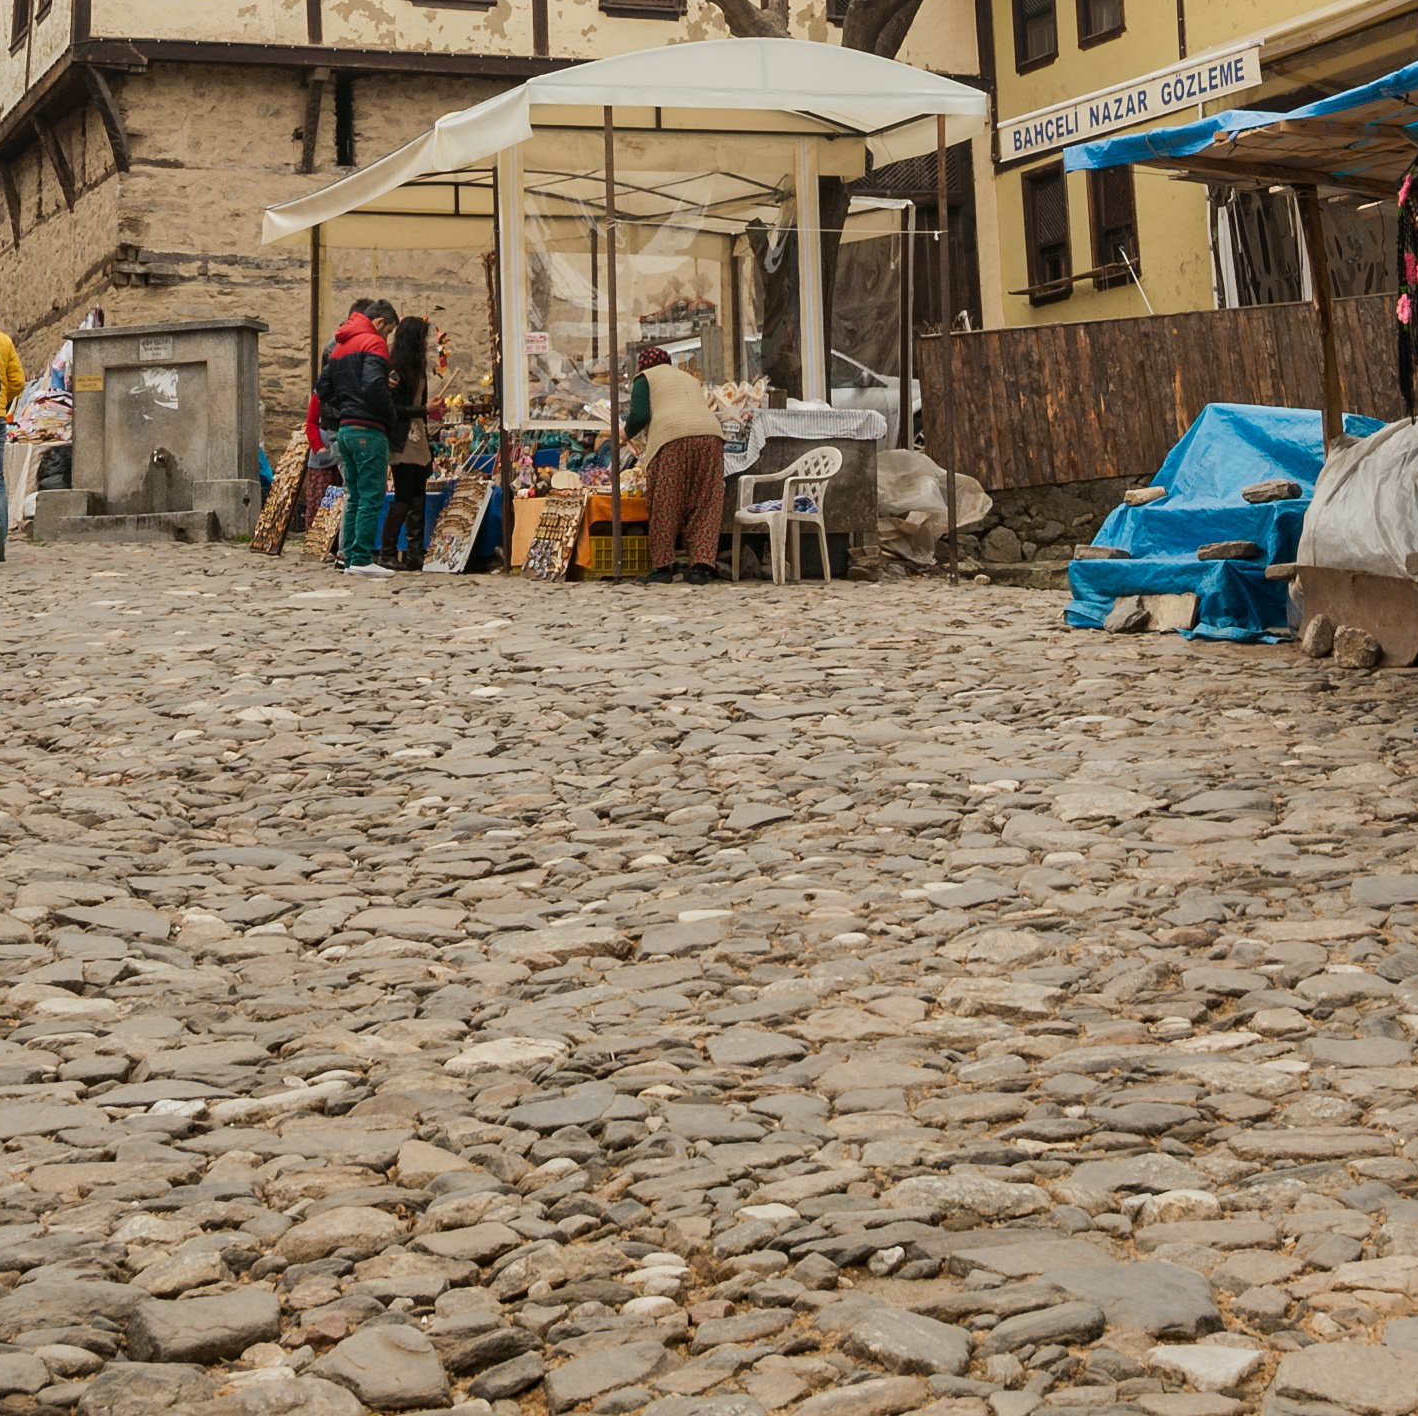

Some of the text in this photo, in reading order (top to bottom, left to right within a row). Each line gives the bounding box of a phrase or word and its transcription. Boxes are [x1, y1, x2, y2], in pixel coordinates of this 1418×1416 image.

[1013, 57, 1245, 151] BAHÇELİ NAZAR GÖZLEME
